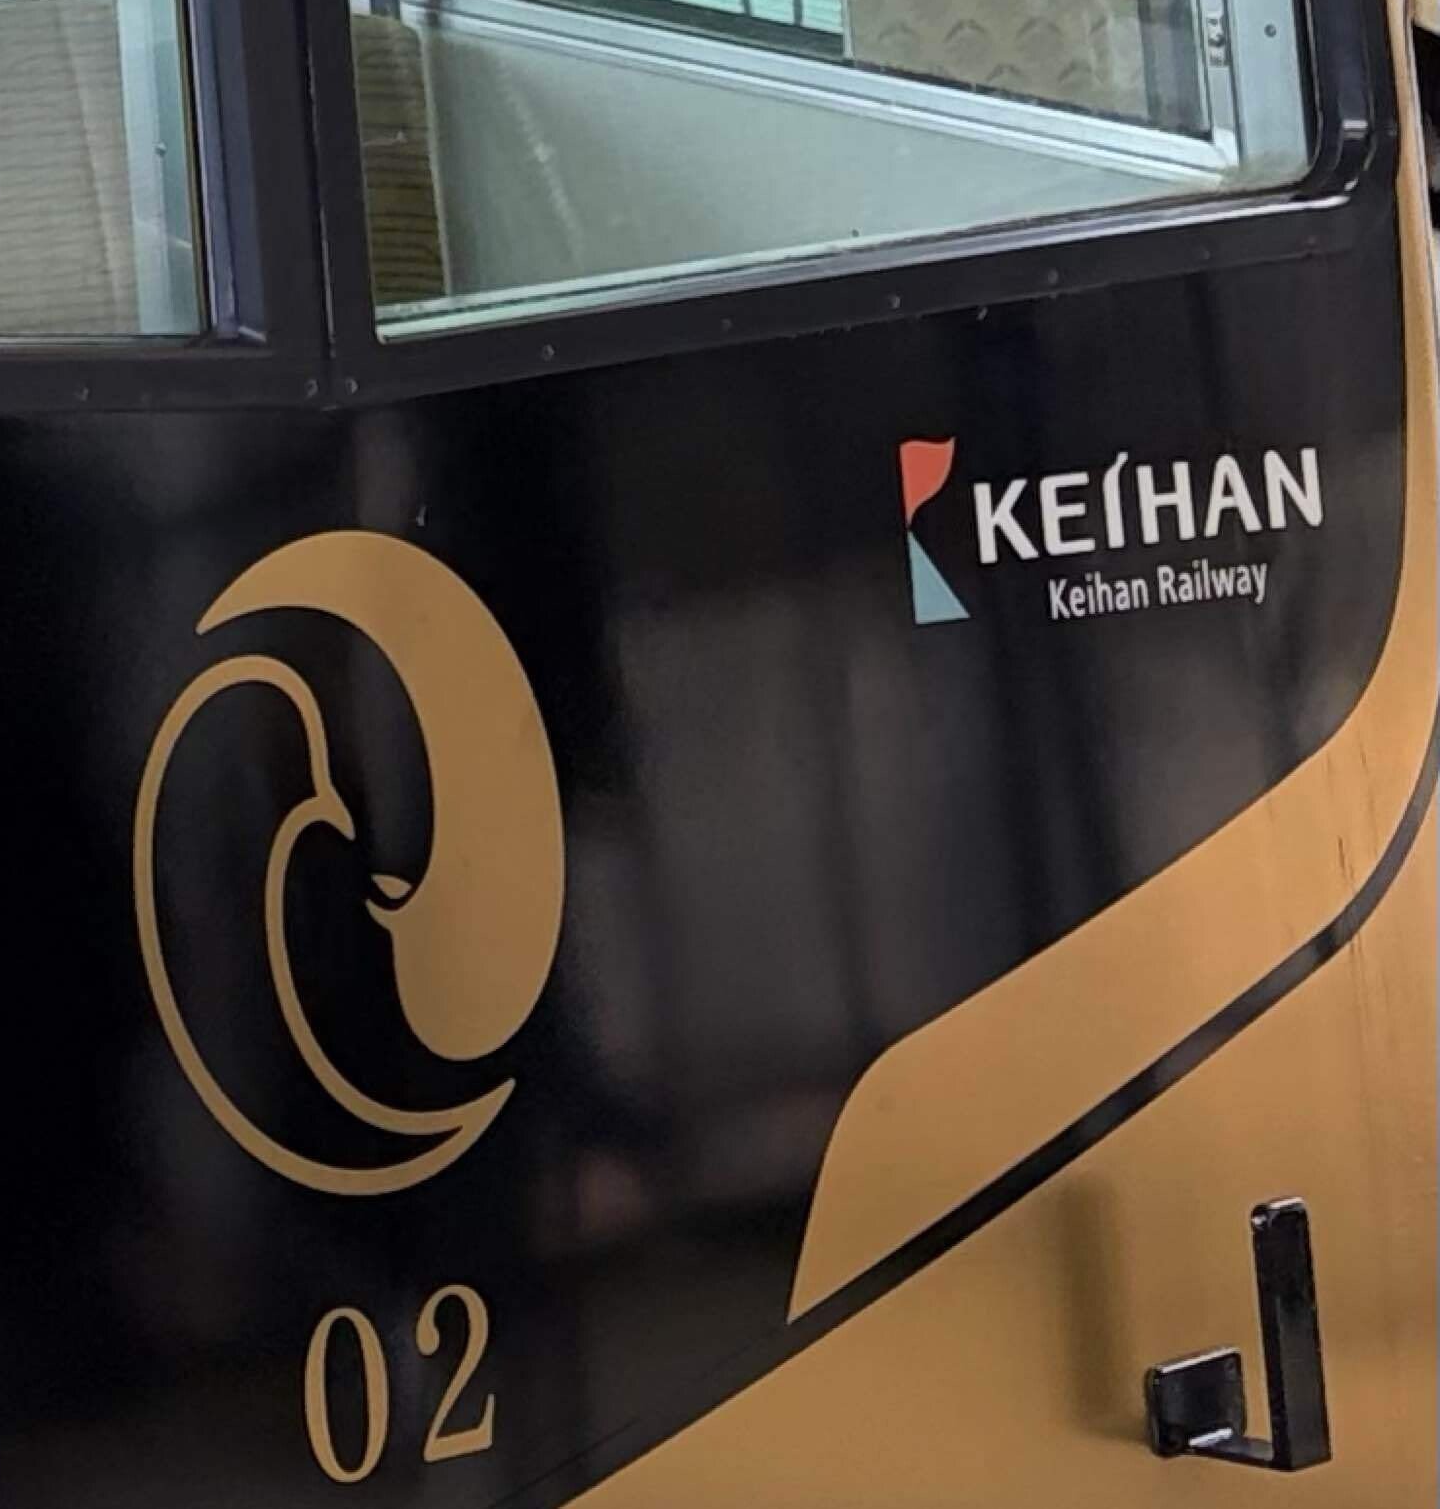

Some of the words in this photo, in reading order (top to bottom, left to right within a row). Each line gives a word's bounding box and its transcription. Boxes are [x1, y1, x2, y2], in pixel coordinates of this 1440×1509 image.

[973, 447, 1324, 564] KEIHAN
[1049, 568, 1150, 620] Keihan
[1157, 558, 1268, 605] Railway
[305, 1284, 495, 1482] 02
